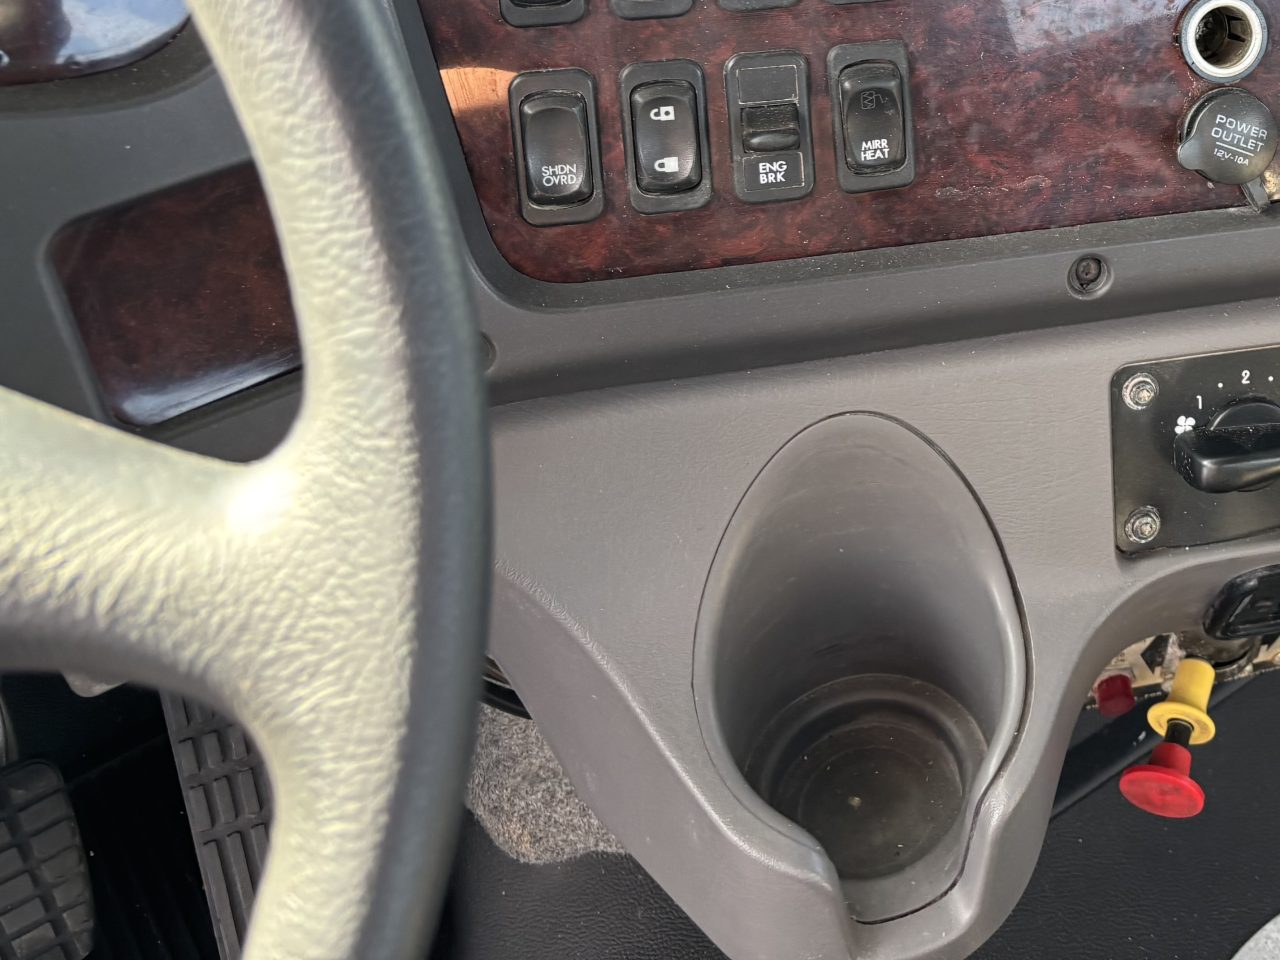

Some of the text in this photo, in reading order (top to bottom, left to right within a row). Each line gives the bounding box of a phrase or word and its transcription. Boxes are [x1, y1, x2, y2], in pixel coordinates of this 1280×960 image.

[1215, 114, 1268, 140] POWER
[861, 138, 889, 151] MIRR
[1211, 127, 1265, 153] OUTLET
[861, 149, 890, 161] HEAT
[541, 164, 577, 176] SHDN
[758, 161, 788, 173] ENG
[542, 174, 577, 187] OVRD
[759, 171, 786, 184] BRK
[1241, 369, 1251, 385] 2
[1195, 394, 1203, 410] 1
